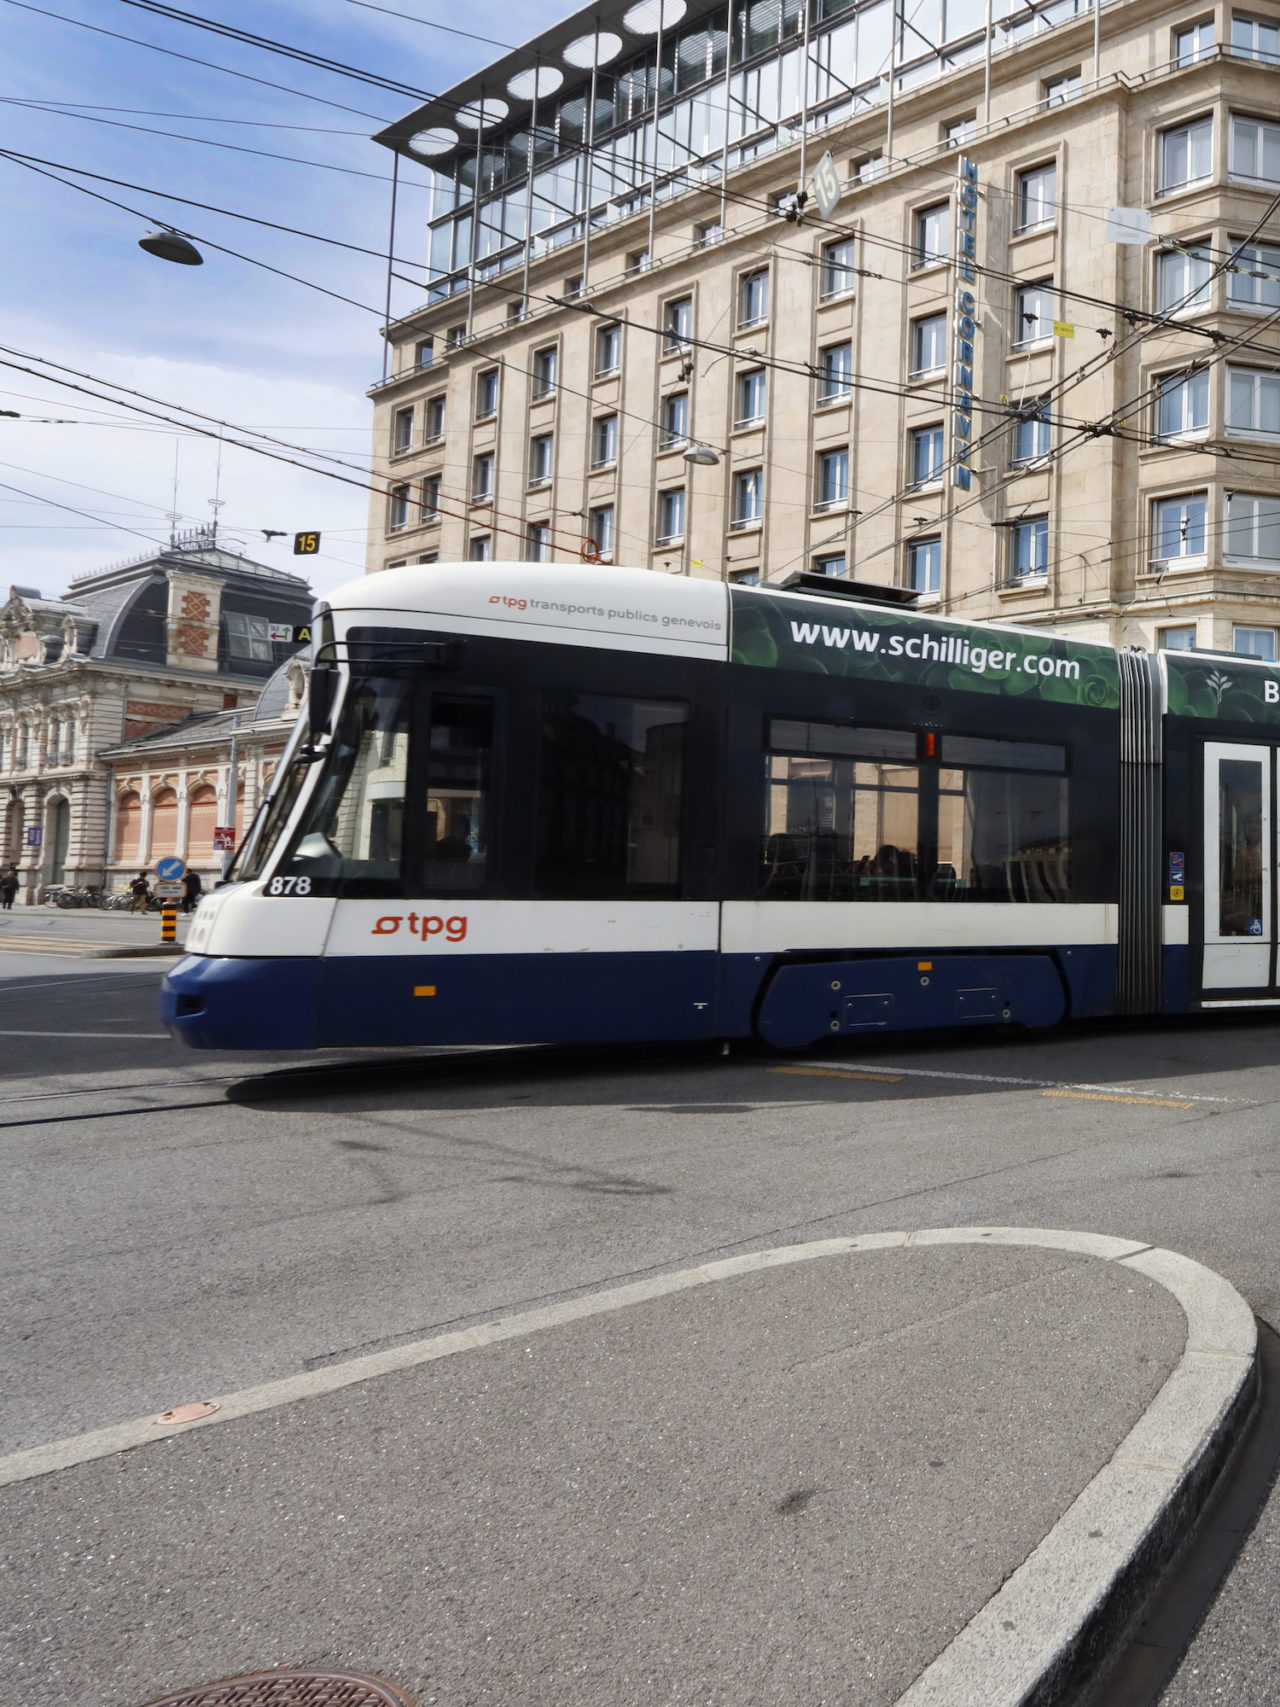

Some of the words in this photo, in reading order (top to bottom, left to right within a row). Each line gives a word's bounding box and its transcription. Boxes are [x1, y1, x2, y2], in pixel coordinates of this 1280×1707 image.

[816, 161, 836, 209] 15
[963, 156, 978, 283] HOTEL
[957, 290, 976, 492] CORNAVIN
[299, 535, 316, 551] 15
[502, 595, 527, 611] tpg
[529, 598, 605, 617] transports
[608, 606, 659, 623] publics
[661, 614, 721, 631] genevois
[790, 620, 1081, 680] www.schilliger.com
[269, 876, 311, 895] 878
[408, 912, 467, 942] tpg
